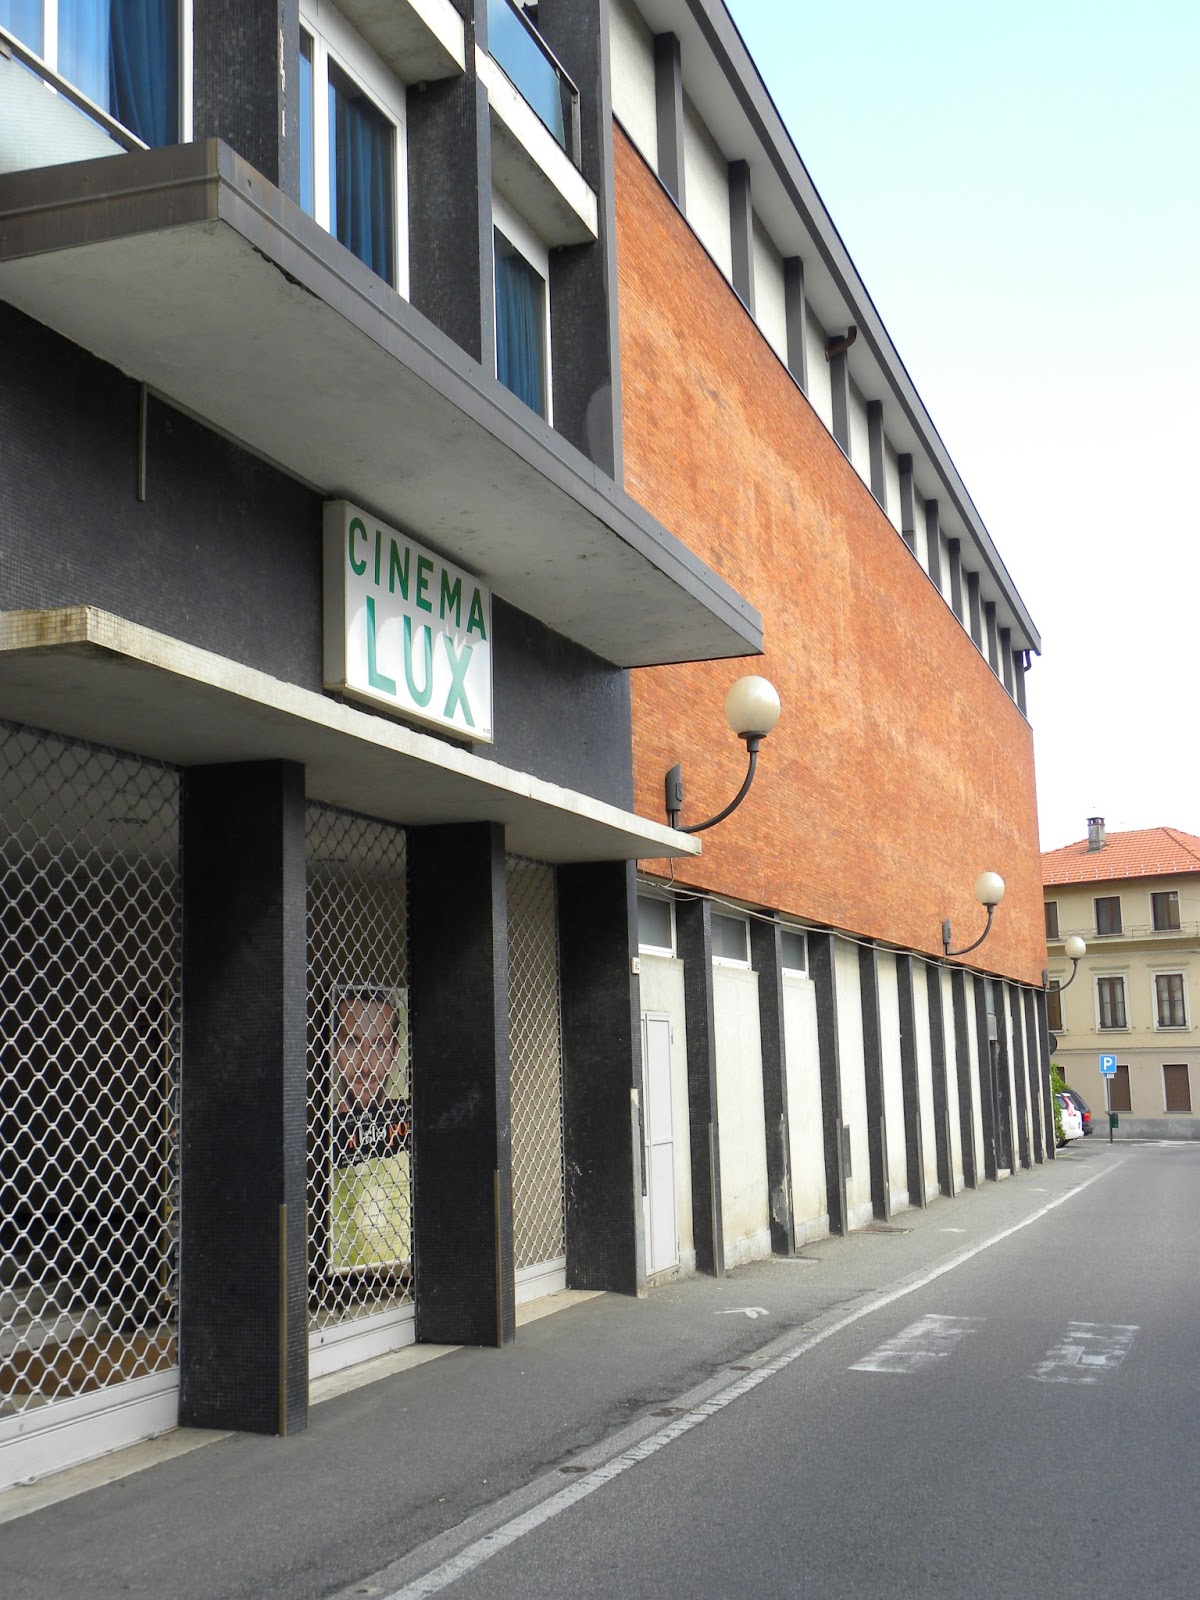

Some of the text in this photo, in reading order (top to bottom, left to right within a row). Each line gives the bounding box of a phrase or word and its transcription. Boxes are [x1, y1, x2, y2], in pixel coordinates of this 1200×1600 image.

[349, 517, 487, 640] CINEMA
[366, 595, 475, 728] LUX
[1103, 1057, 1113, 1071] P
